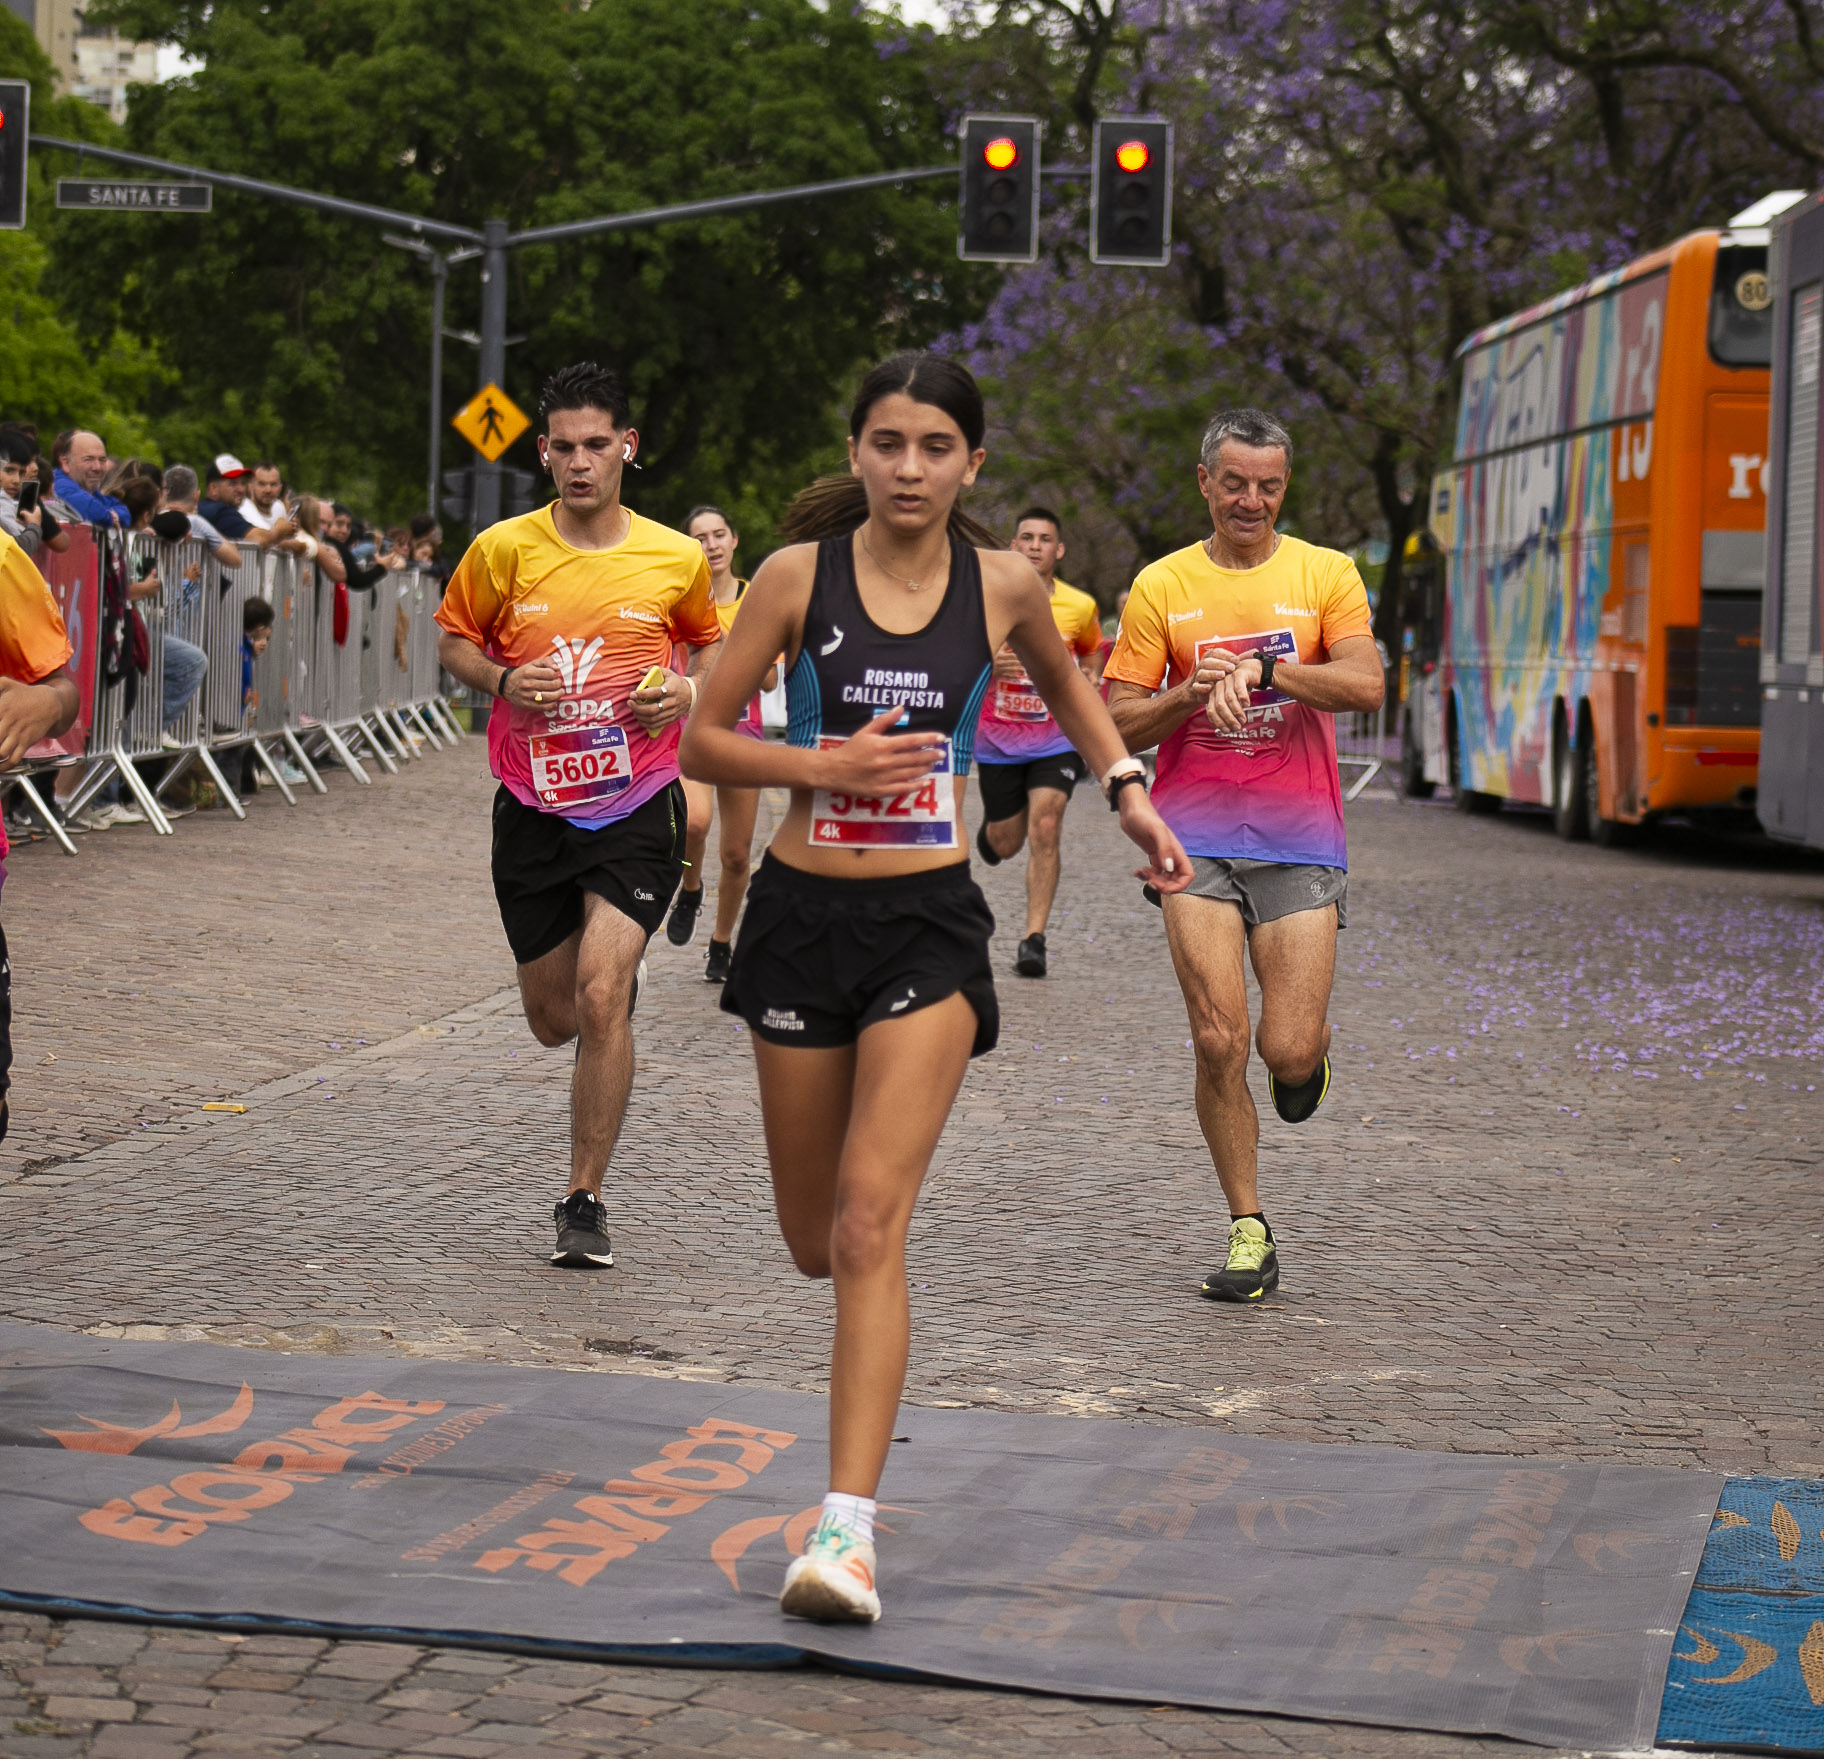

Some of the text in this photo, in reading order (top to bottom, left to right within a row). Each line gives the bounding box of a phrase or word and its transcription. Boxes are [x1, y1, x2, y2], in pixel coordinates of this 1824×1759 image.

[89, 186, 180, 206] SANTA FE
[1741, 280, 1768, 303] 80
[1728, 452, 1771, 500] r
[1263, 641, 1290, 653] Santa Fe
[864, 669, 929, 688] ROSARIO
[842, 686, 945, 709] CALLEYPISTA
[1003, 695, 1043, 712] 5960
[592, 735, 619, 745] Santa Fe
[1259, 726, 1276, 739] Fe
[545, 750, 620, 786] 5602
[543, 790, 559, 802] 4k
[829, 778, 939, 818] 5424
[819, 823, 841, 839] 4k
